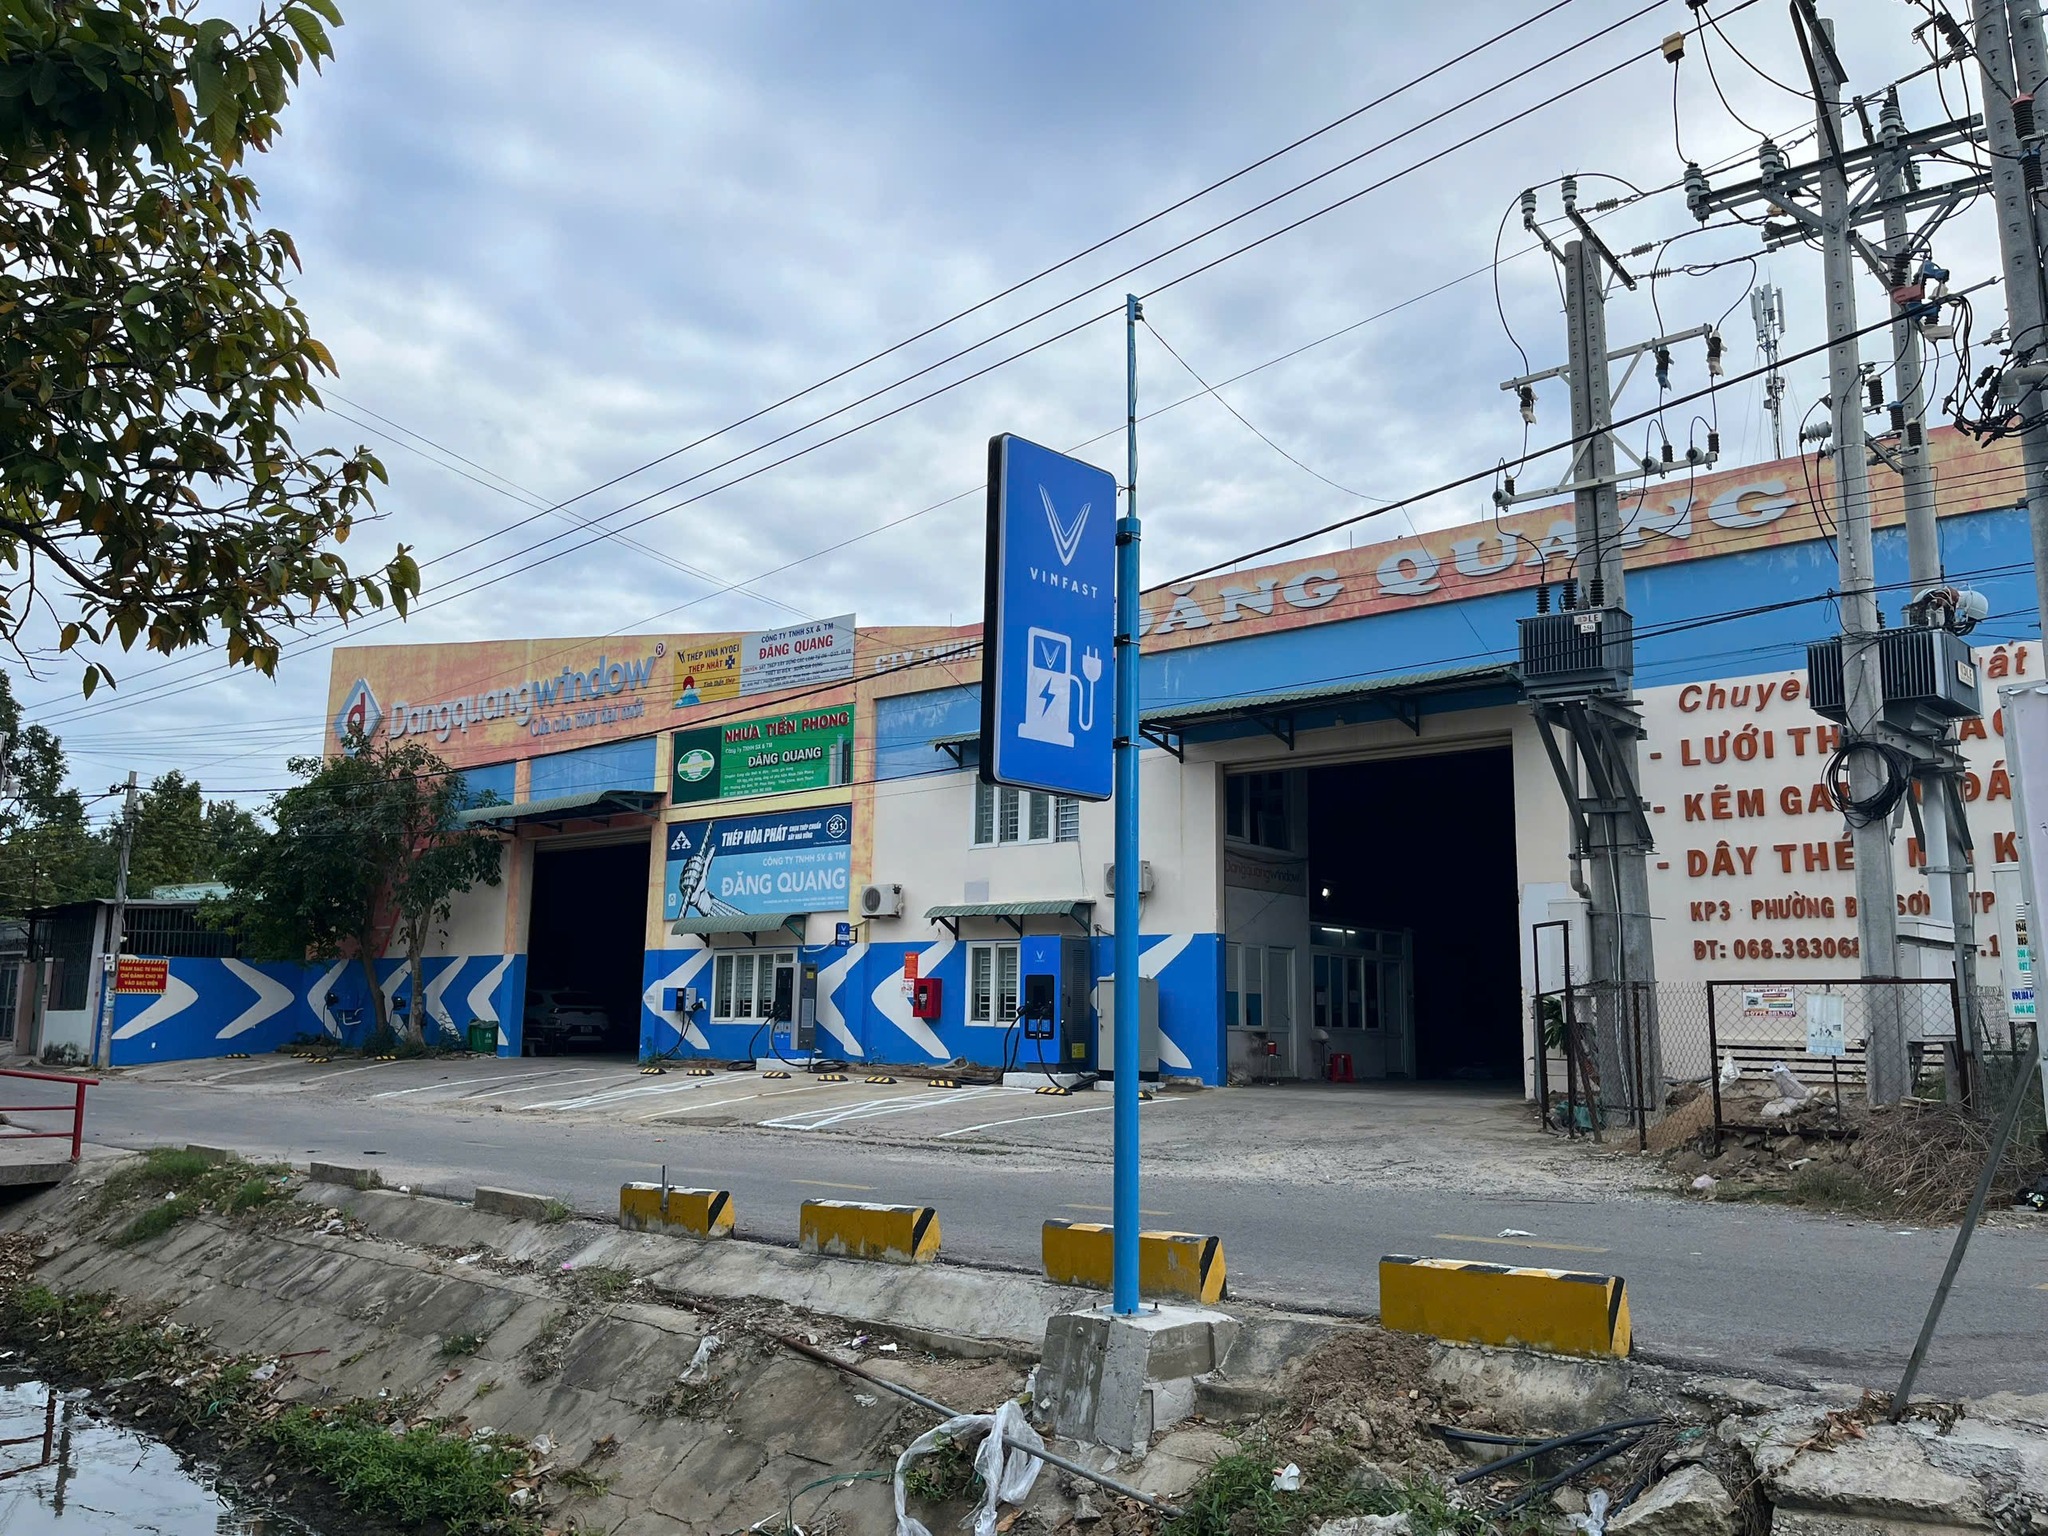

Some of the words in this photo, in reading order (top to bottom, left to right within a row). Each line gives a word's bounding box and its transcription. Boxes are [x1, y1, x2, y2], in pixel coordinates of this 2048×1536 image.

[1030, 567, 1098, 599] VINFAST
[761, 633, 778, 644] CÔNG
[778, 631, 787, 640] TY
[788, 628, 805, 638] TNHH
[805, 626, 814, 635] SX
[824, 622, 834, 630] TM
[705, 648, 719, 659] VINA
[720, 643, 740, 656] KYOEI
[758, 642, 790, 660] ĐĂNG
[794, 635, 834, 654] QUANG
[875, 650, 914, 673] CTY
[389, 655, 656, 743] Dangquangwindow
[766, 716, 797, 737] TIỀN
[801, 711, 849, 732] PHONG
[748, 751, 778, 768] ĐĂNG
[781, 746, 822, 763] QUANG
[1680, 723, 1775, 766] LƯỚI
[1684, 783, 1765, 822] KẼM
[722, 829, 743, 847] THÉP
[744, 827, 762, 845] HÒA
[764, 824, 788, 843] PHÁT
[763, 856, 783, 866] CÔNG
[784, 856, 793, 864] TY
[795, 855, 815, 864] TNHH
[816, 854, 826, 862] SX
[827, 853, 833, 861] &
[835, 852, 846, 860] TM
[1686, 840, 1758, 878] DÂY
[721, 871, 772, 897] ĐĂNG
[777, 867, 846, 893] QUANG
[1690, 900, 1731, 922] KP3
[1750, 890, 1835, 920] PHƯỜNG
[1693, 940, 1727, 960] ĐT:
